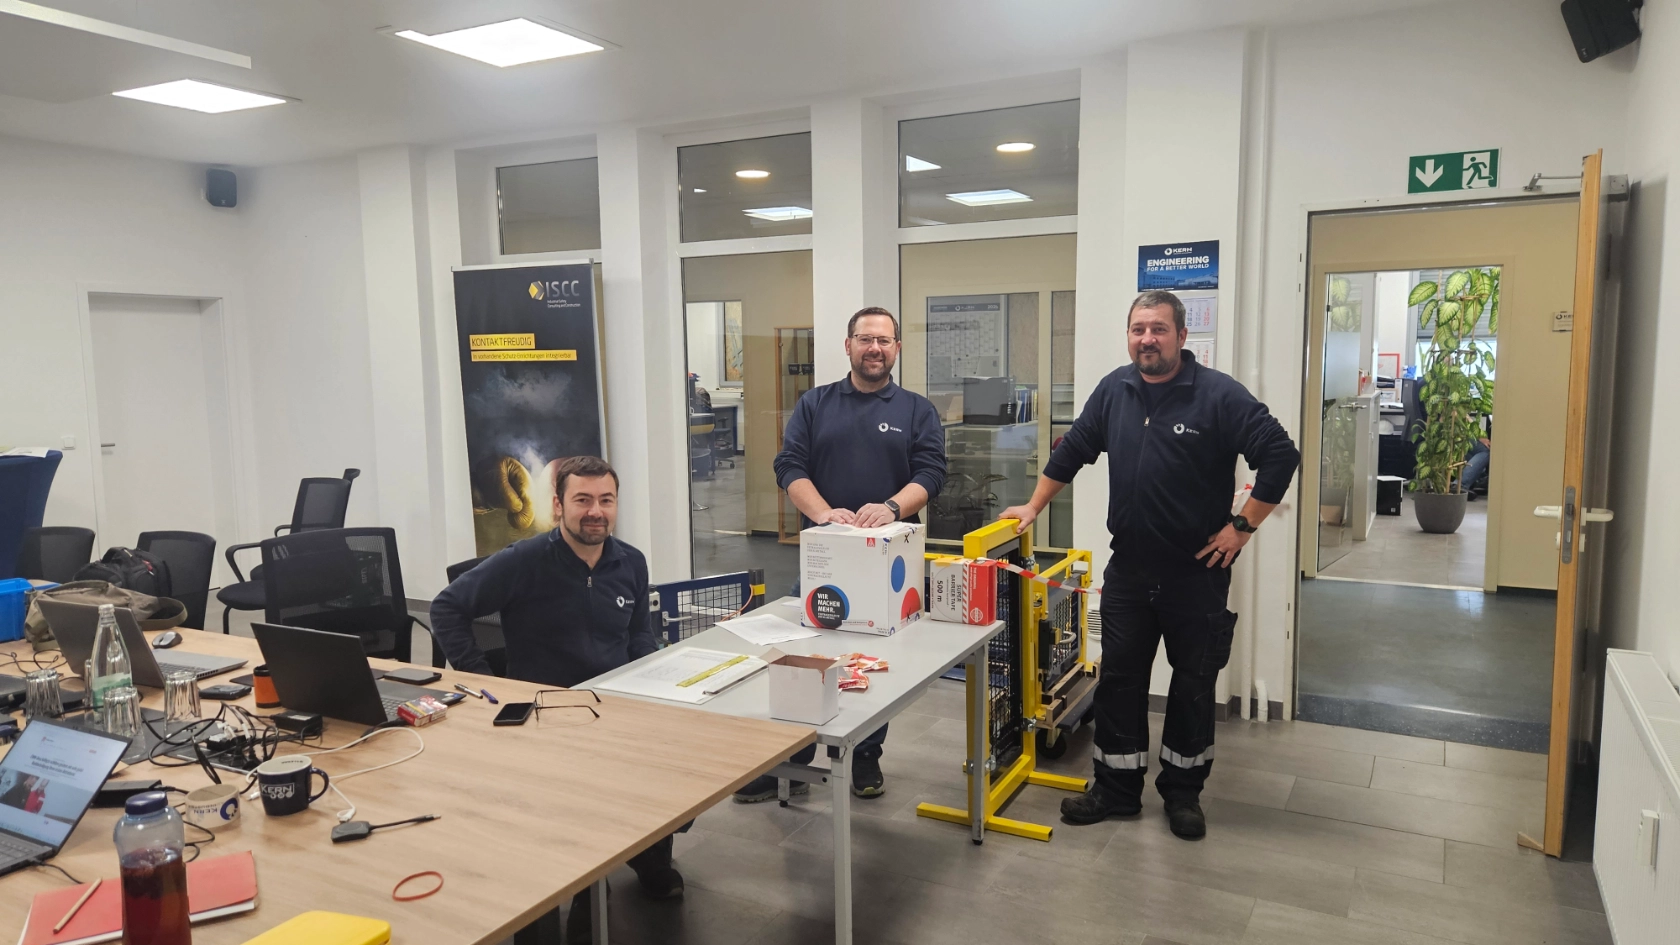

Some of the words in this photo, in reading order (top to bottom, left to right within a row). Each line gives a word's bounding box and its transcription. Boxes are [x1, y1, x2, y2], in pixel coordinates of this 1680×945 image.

[1147, 256, 1209, 267] ENGINEERING
[545, 280, 580, 298] ISCC
[471, 336, 532, 347] KONTAKTFREUDIG
[817, 592, 829, 600] WIR
[817, 599, 840, 607] MACHEN
[261, 784, 292, 794] KERN
